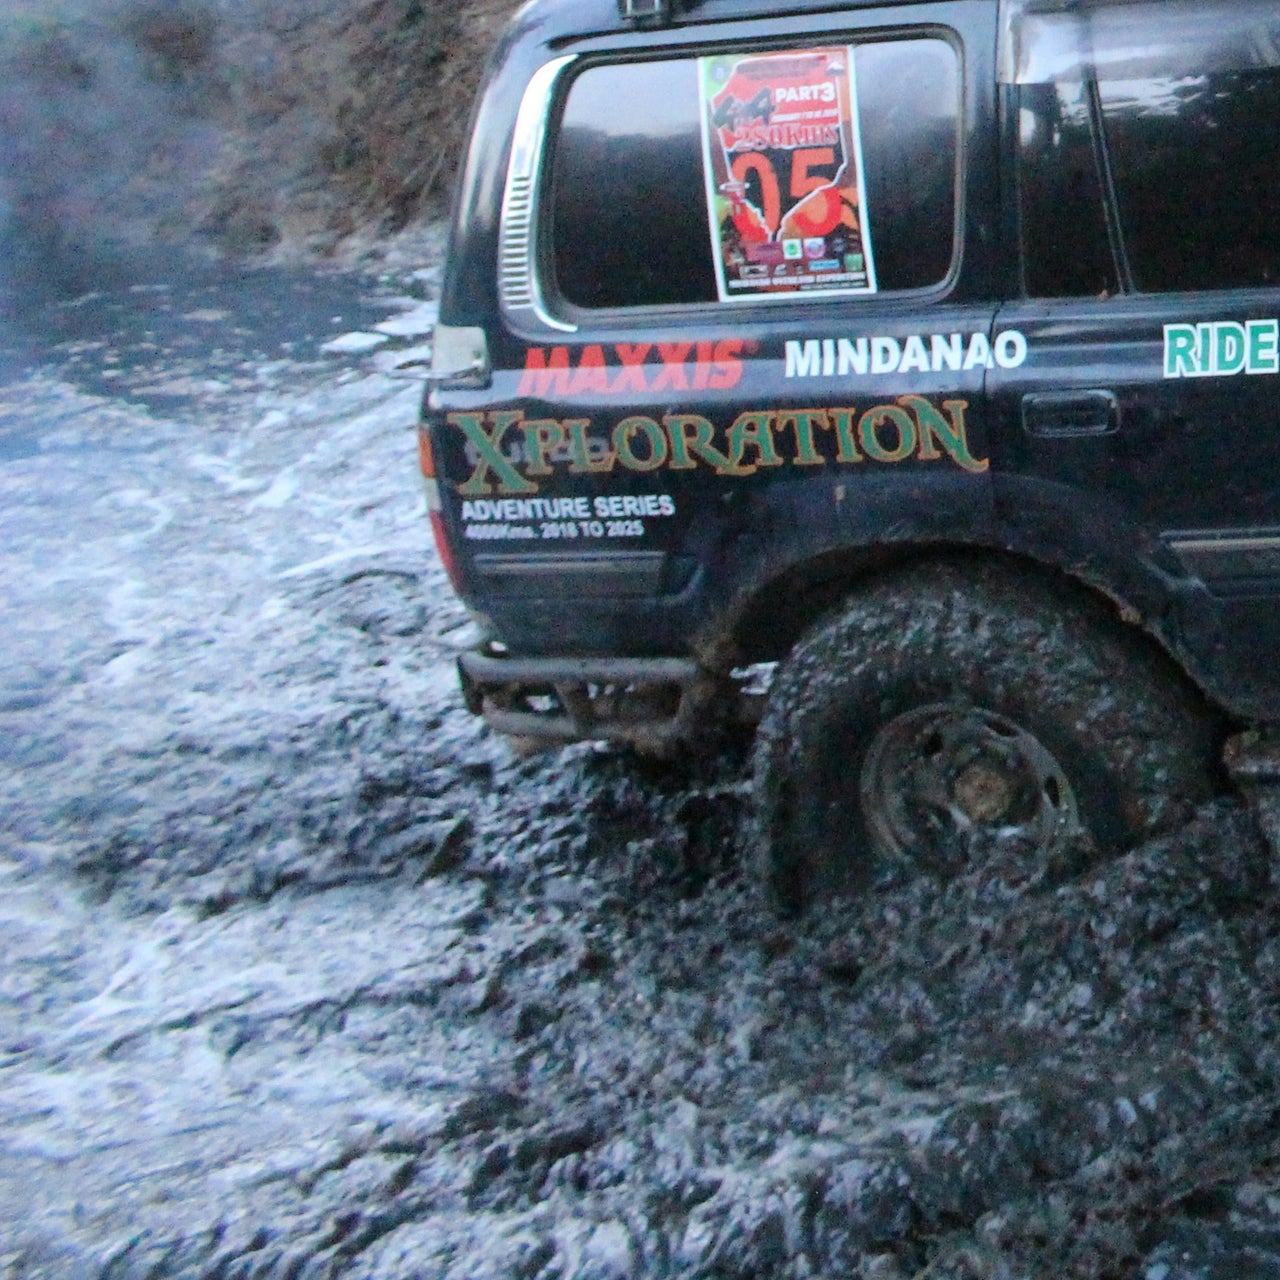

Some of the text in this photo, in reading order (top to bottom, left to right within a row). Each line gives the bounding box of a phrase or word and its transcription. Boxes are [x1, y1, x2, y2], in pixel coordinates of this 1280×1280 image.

[516, 329, 1028, 397] MAXXIS MINDANAO
[447, 394, 990, 496] XPLORATION
[461, 494, 676, 521] ADVENTURE SERIES
[580, 521, 604, 537] TO
